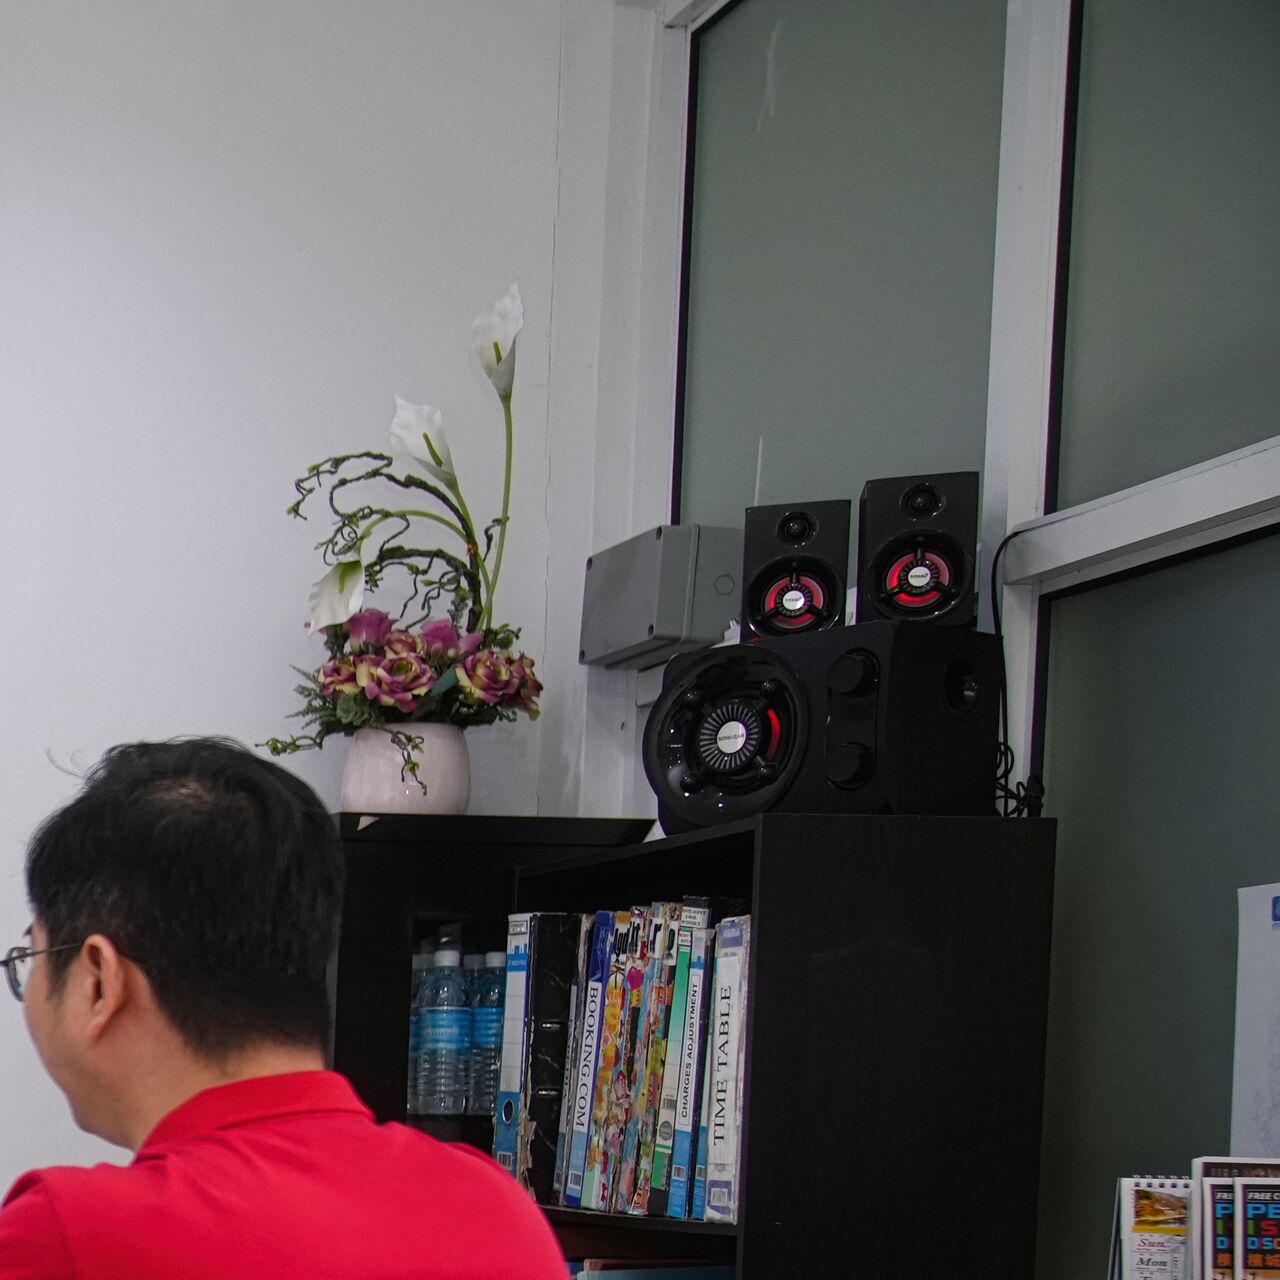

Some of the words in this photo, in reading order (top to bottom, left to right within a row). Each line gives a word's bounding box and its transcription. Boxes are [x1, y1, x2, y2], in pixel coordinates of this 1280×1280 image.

[686, 983, 699, 1059] ADJUSTMENT
[717, 985, 732, 1067] TABLE
[575, 986, 599, 1128] BOOKING.COM
[681, 1061, 692, 1118] CHARGES
[713, 1079, 728, 1146] TIME
[1248, 1192, 1271, 1200] FREE
[1136, 1256, 1168, 1267] Mon
[1137, 1238, 1166, 1248] Sun
